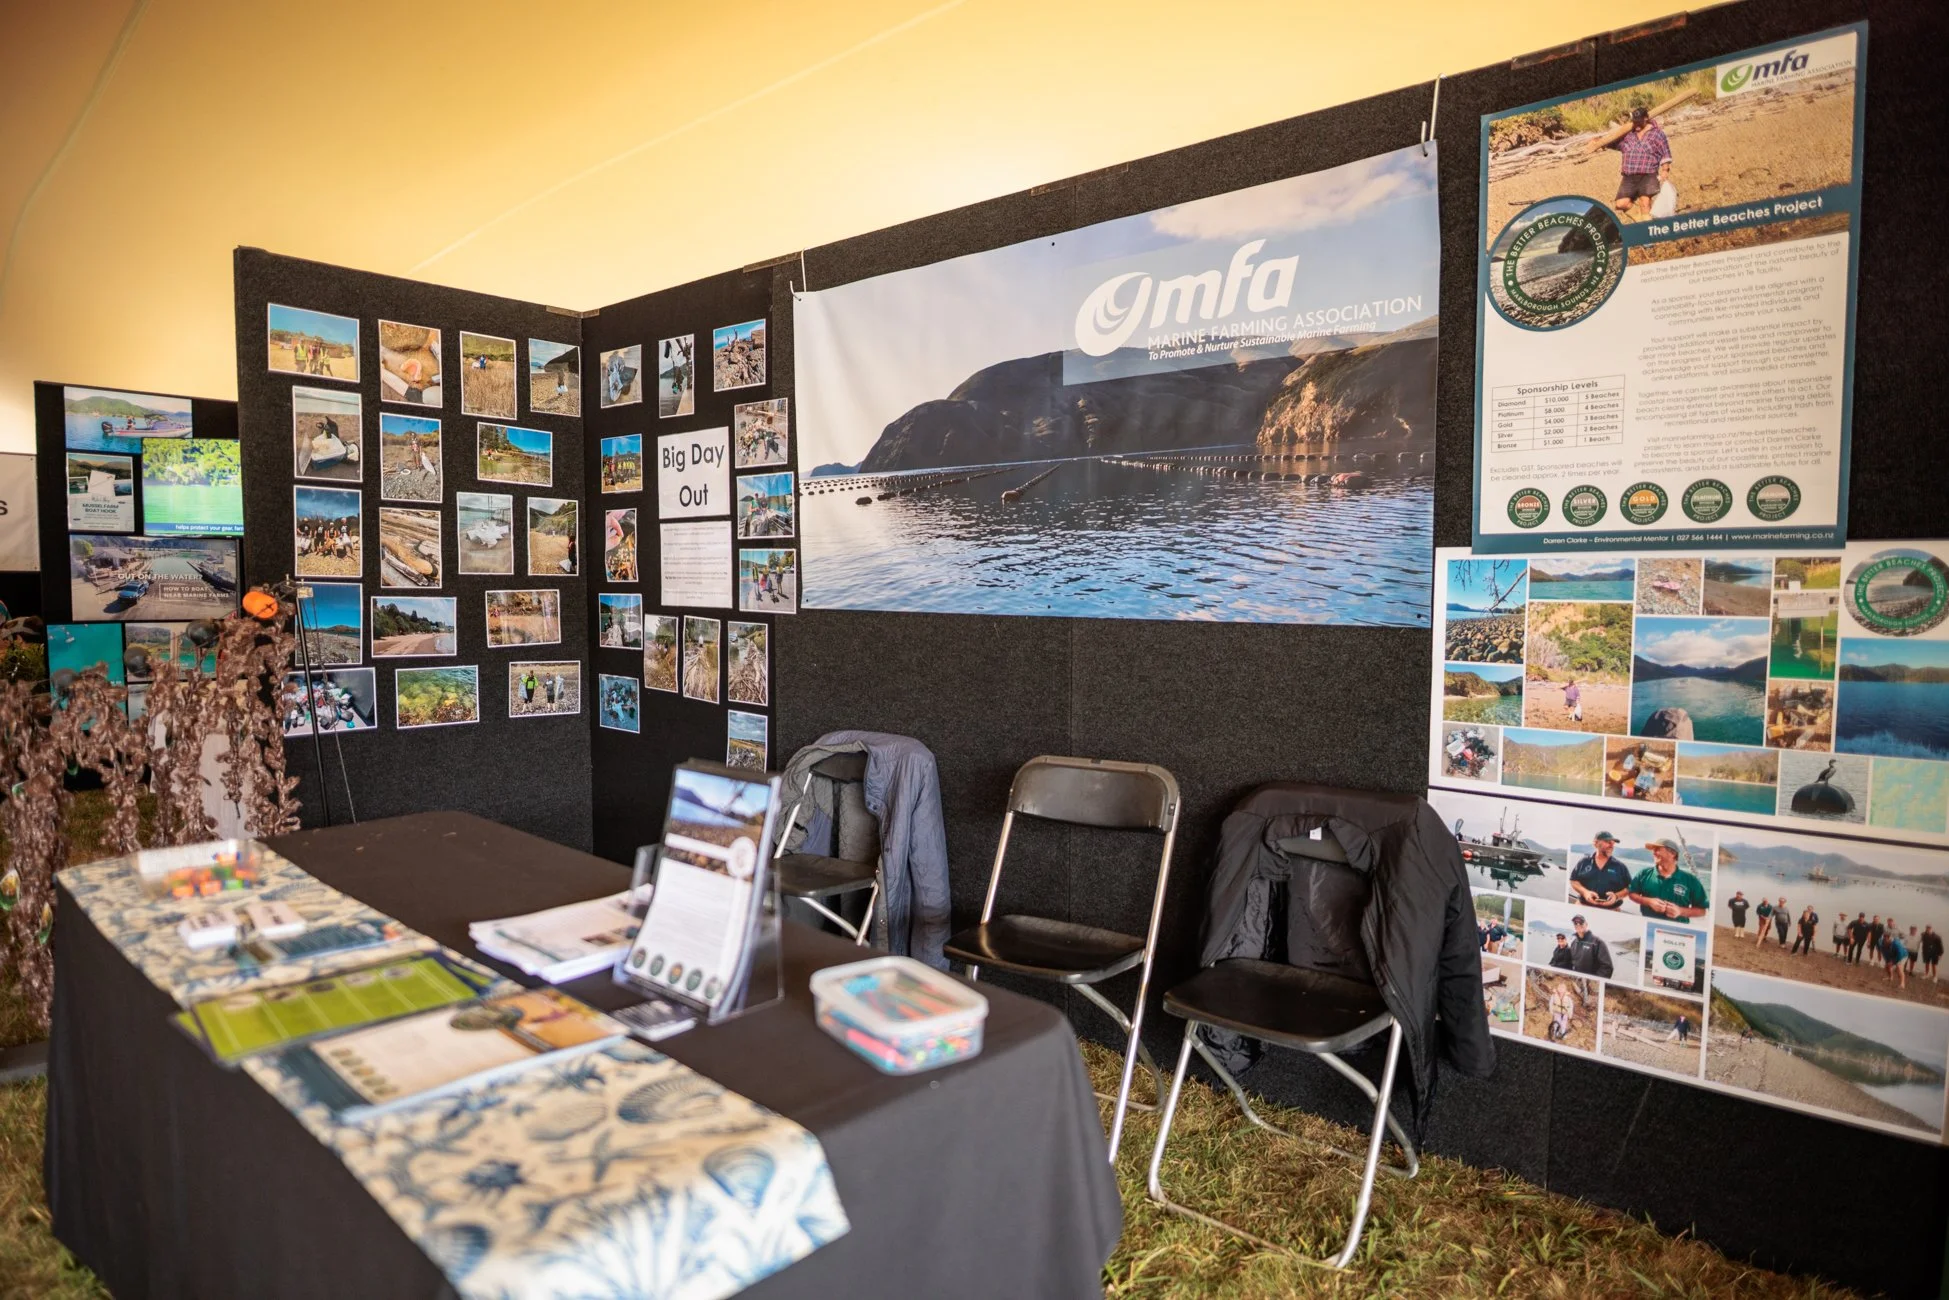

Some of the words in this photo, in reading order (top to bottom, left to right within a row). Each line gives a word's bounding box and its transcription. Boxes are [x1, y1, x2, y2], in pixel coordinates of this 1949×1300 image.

[1753, 50, 1809, 80] mfa
[1808, 60, 1852, 74] ASSOCIATION
[1648, 222, 1669, 236] The
[1673, 216, 1708, 232] Better
[1712, 205, 1769, 225] Beaches
[1774, 195, 1822, 217] Project
[1506, 260, 1514, 276] THE
[1510, 228, 1536, 256] BETTER
[1538, 216, 1584, 230] BEACHES
[1584, 223, 1605, 263] PROJECT
[1150, 239, 1299, 328] mfa
[1511, 288, 1559, 311] MARLBOROUGH
[1148, 329, 1205, 350] MARINE
[1212, 316, 1287, 340] FARMING
[1293, 296, 1422, 328] ASSOCIATION
[1149, 351, 1158, 360] To
[1160, 348, 1195, 359] Promote
[1197, 345, 1203, 353] &
[1205, 340, 1238, 352] Nurture
[1240, 331, 1296, 347] Sustainable
[1297, 326, 1332, 340] Marine
[1334, 320, 1376, 335] Farming
[1517, 382, 1568, 395] Sponsorship
[1571, 380, 1598, 389] Levels
[663, 446, 685, 472] Big
[692, 444, 724, 468] Day
[680, 484, 708, 507] Out
[1731, 531, 1834, 541] www.marinefarming.co.nz
[1862, 562, 1884, 582] BETTER
[1886, 559, 1926, 569] BEACHES
